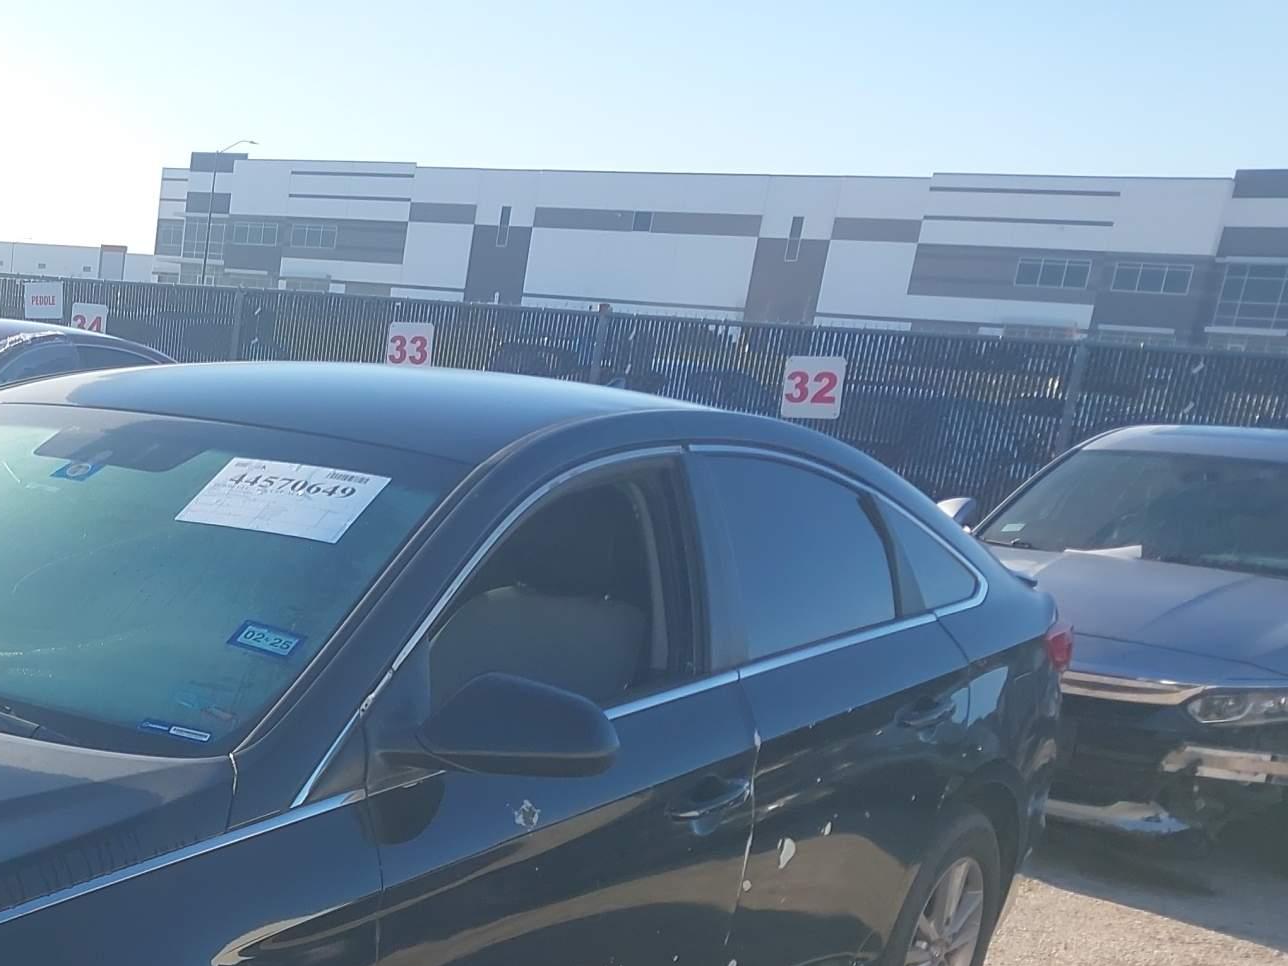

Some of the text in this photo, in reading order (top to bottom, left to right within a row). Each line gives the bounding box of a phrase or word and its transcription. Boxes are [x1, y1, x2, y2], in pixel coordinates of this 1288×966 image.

[388, 335, 428, 365] 33
[784, 371, 838, 404] 32
[229, 472, 356, 499] 44570649
